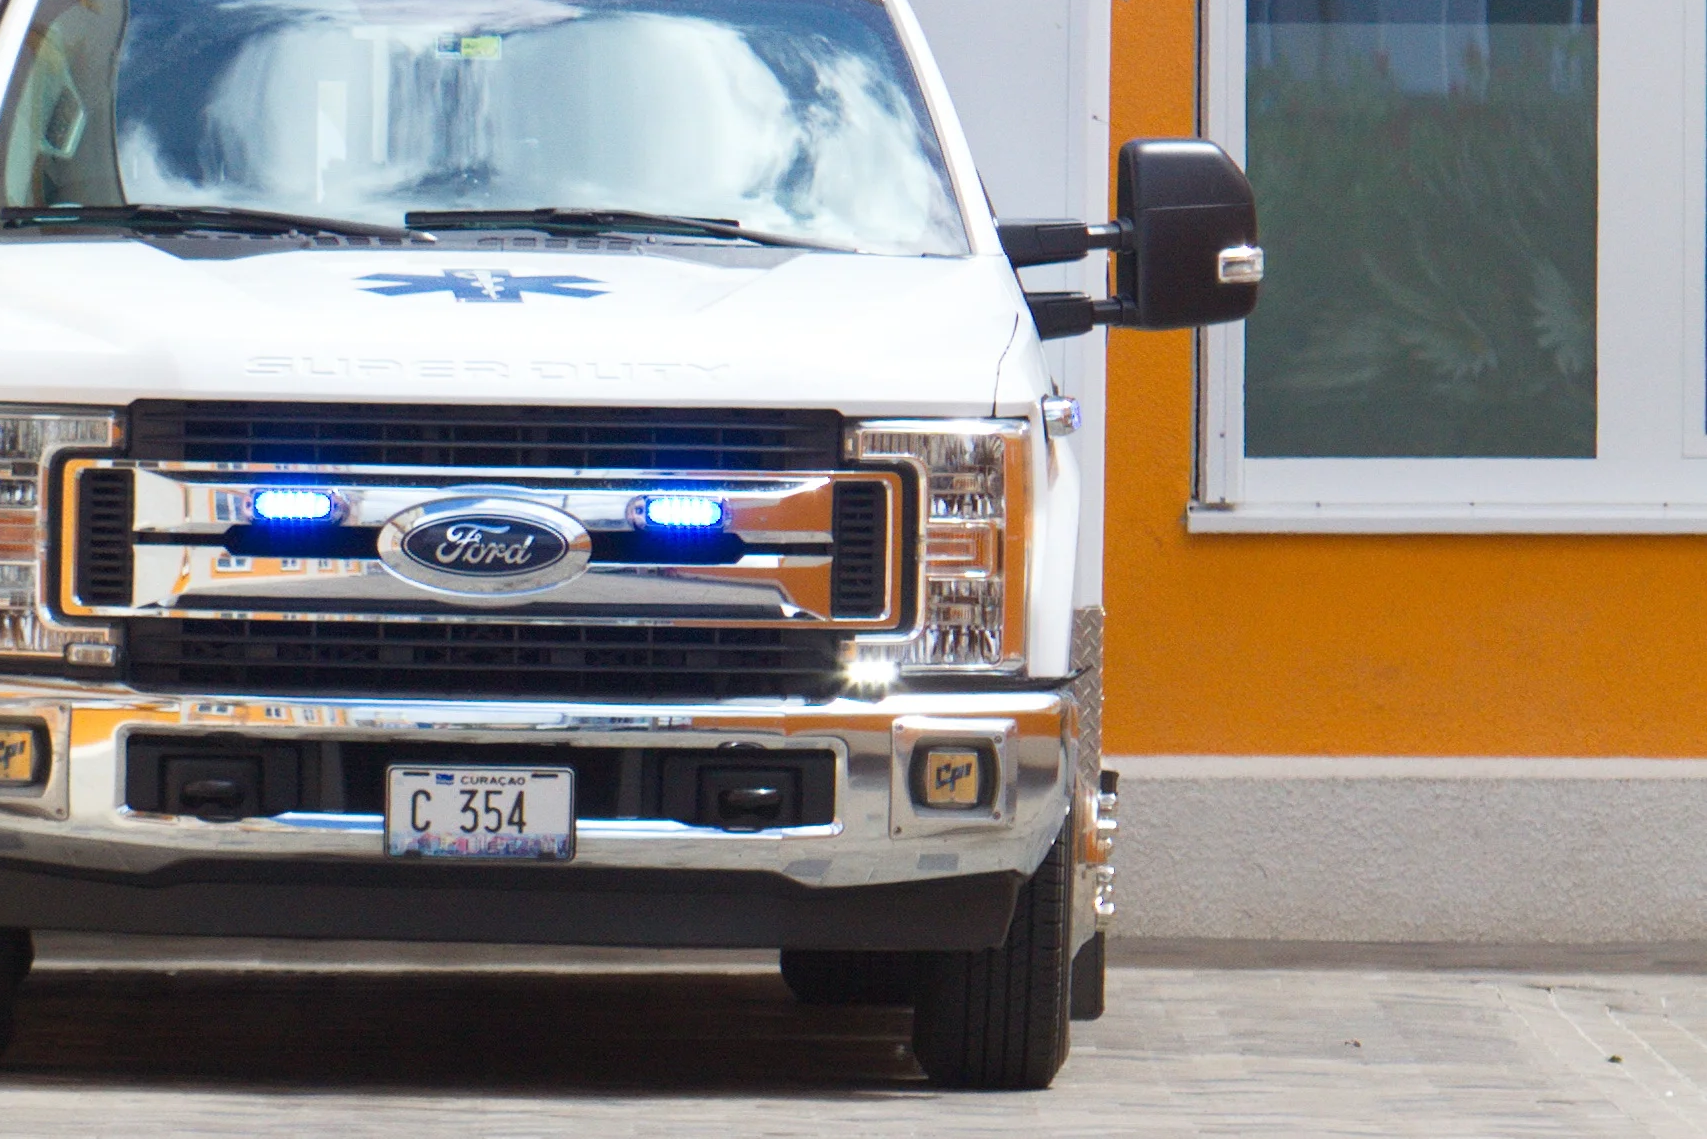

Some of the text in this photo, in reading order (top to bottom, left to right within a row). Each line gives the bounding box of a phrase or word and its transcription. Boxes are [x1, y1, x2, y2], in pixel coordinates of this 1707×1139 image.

[244, 355, 731, 384] SUPER DUTY
[436, 523, 535, 564] Ford
[460, 775, 526, 787] CURAÇAO
[411, 789, 527, 834] C 354
